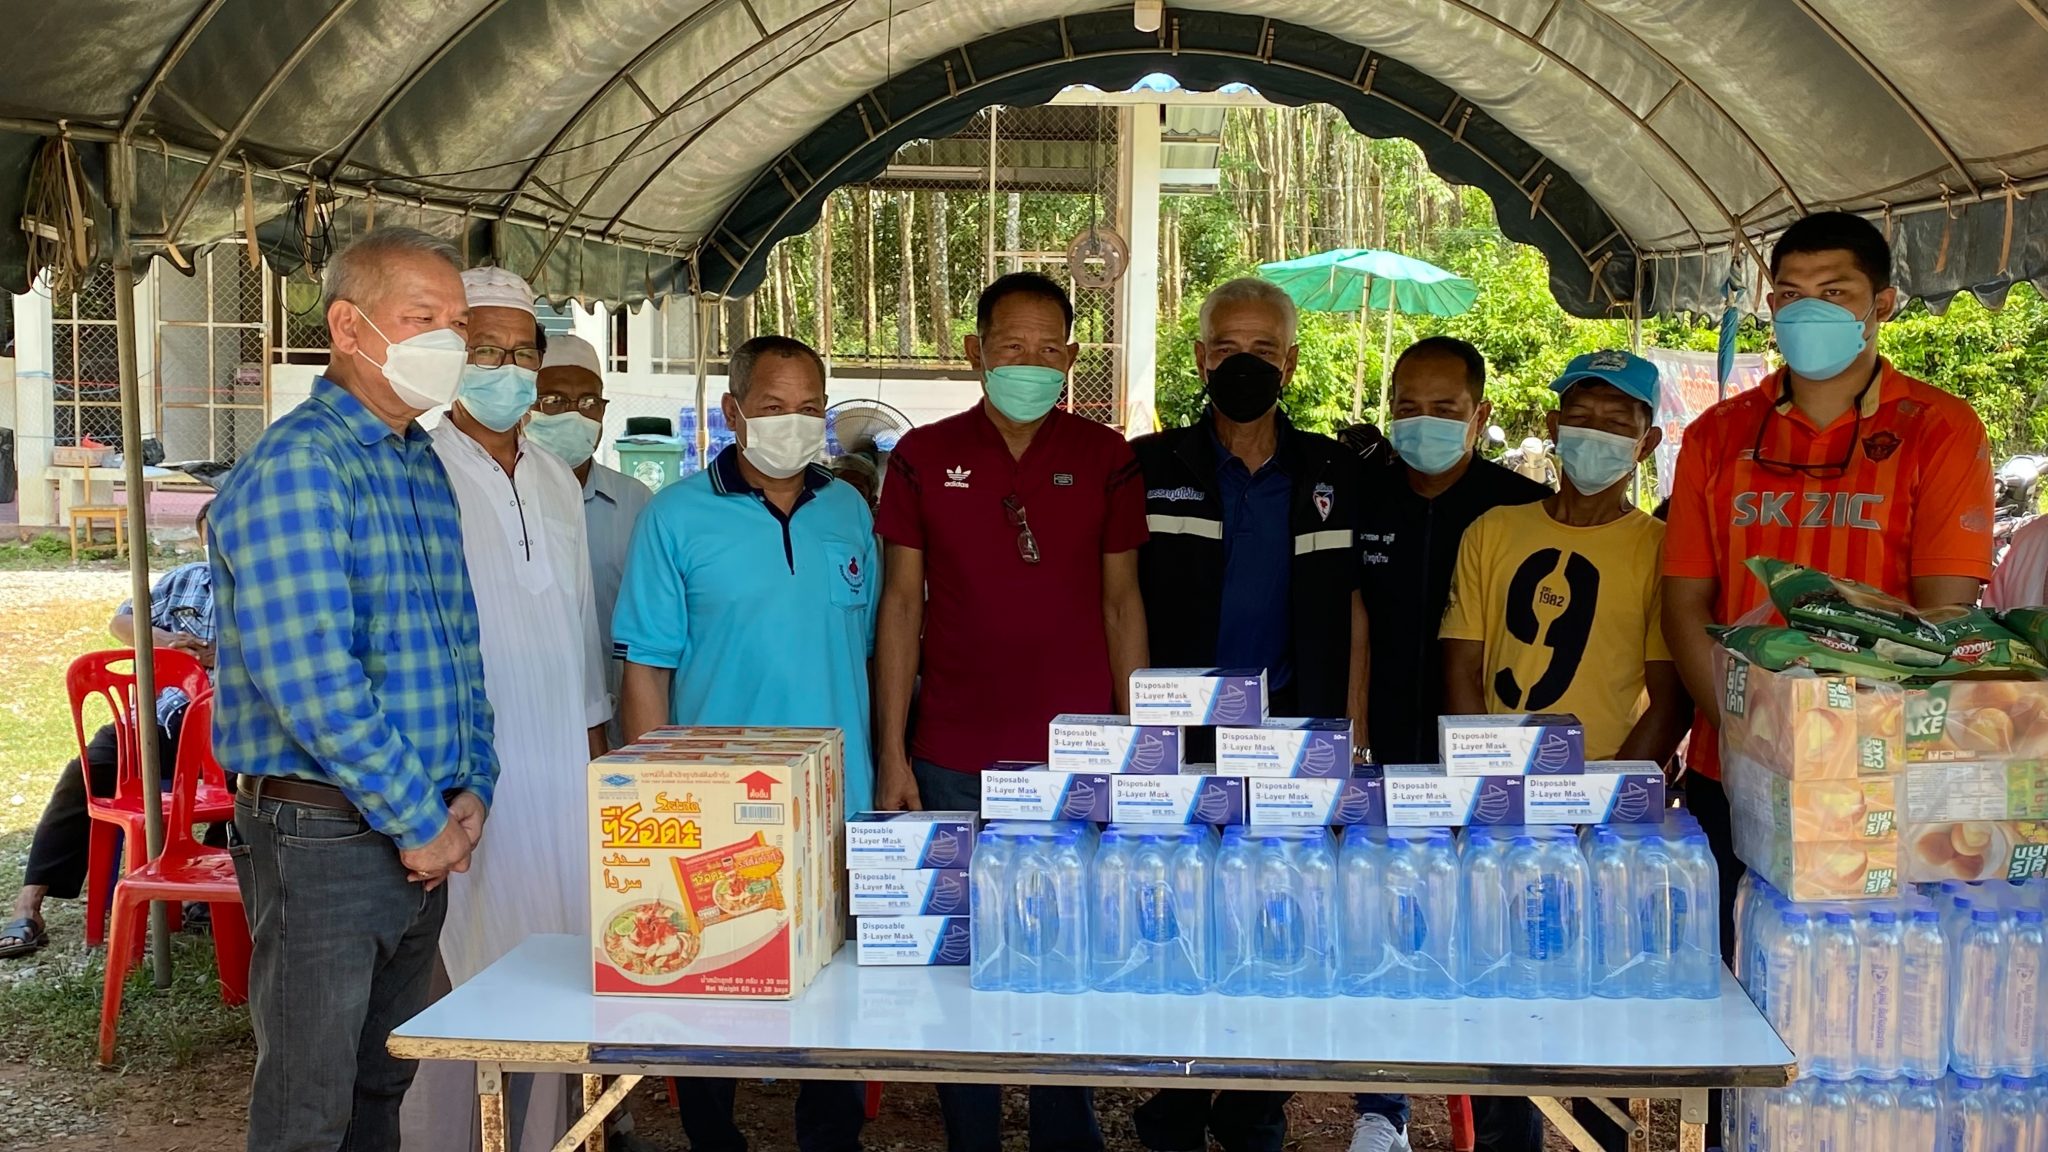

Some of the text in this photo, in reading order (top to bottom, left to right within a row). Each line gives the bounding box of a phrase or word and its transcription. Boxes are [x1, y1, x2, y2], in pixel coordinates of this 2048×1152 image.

[1732, 492, 1885, 530] SK ZIC
[1538, 591, 1565, 607] 1982
[1135, 682, 1178, 690] Disposable
[1136, 692, 1164, 700] 3-Layer
[1055, 729, 1096, 737] Disposable
[1222, 733, 1266, 741] Disposable
[1055, 739, 1083, 747] 3-Layer
[1222, 743, 1252, 751] 3-Layer
[1873, 739, 1884, 768] CAKE
[987, 776, 1028, 784] Disposable
[1118, 780, 1160, 788] Disposable
[1530, 780, 1576, 788] Disposable
[987, 786, 1015, 794] 3-Layer
[1256, 782, 1300, 790] Disposable
[1393, 782, 1437, 790] Disposable
[1393, 793, 1423, 801] 3-Layer
[863, 933, 891, 941] 3-Layer
[718, 985, 739, 993] Weight
